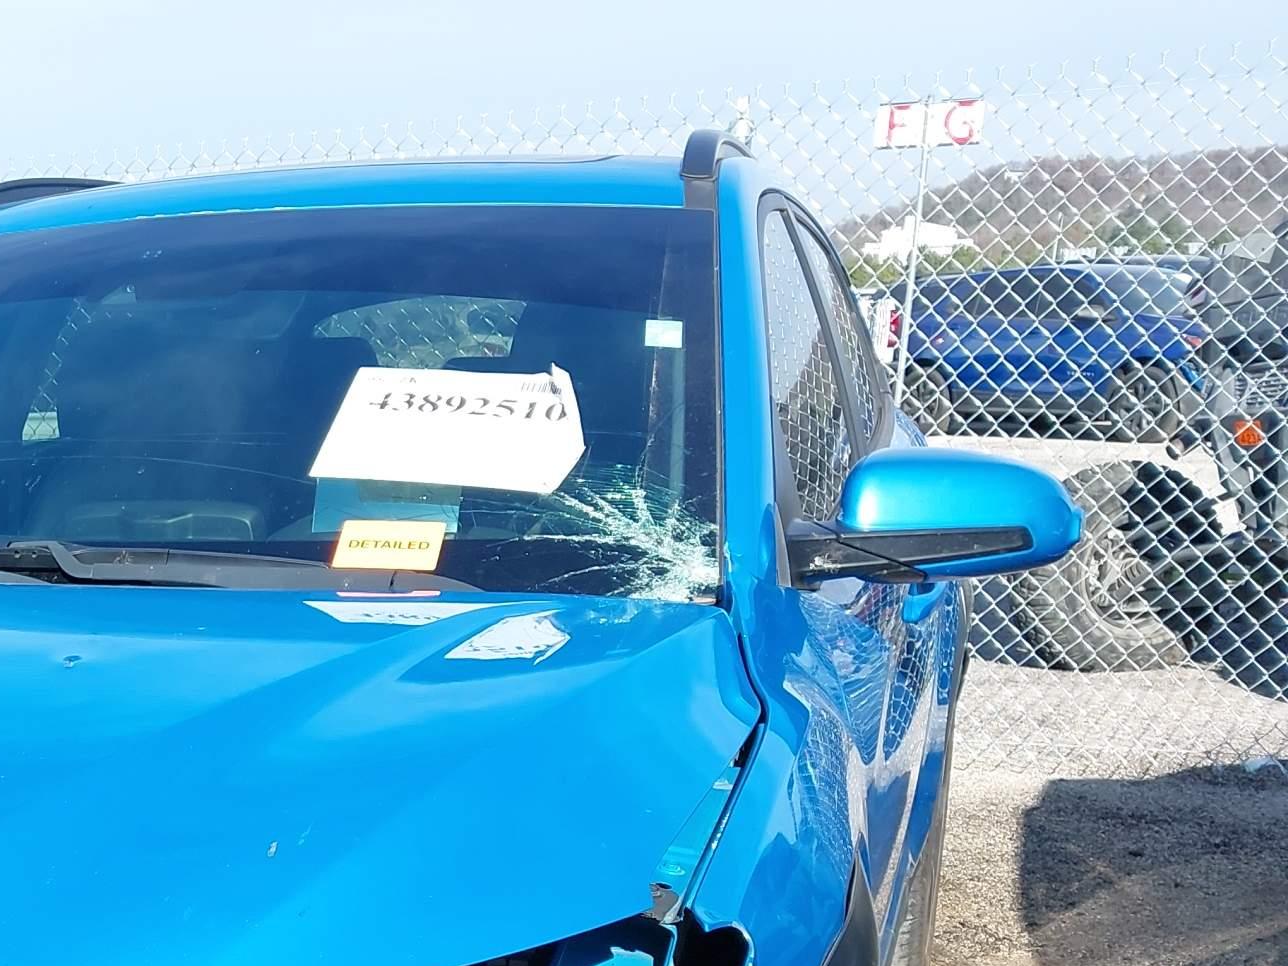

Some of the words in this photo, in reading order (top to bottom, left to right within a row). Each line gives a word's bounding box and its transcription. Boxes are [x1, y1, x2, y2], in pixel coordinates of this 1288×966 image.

[886, 104, 911, 145] F
[944, 100, 976, 145] G
[369, 392, 568, 421] 43892510
[348, 539, 430, 550] DETAILED
